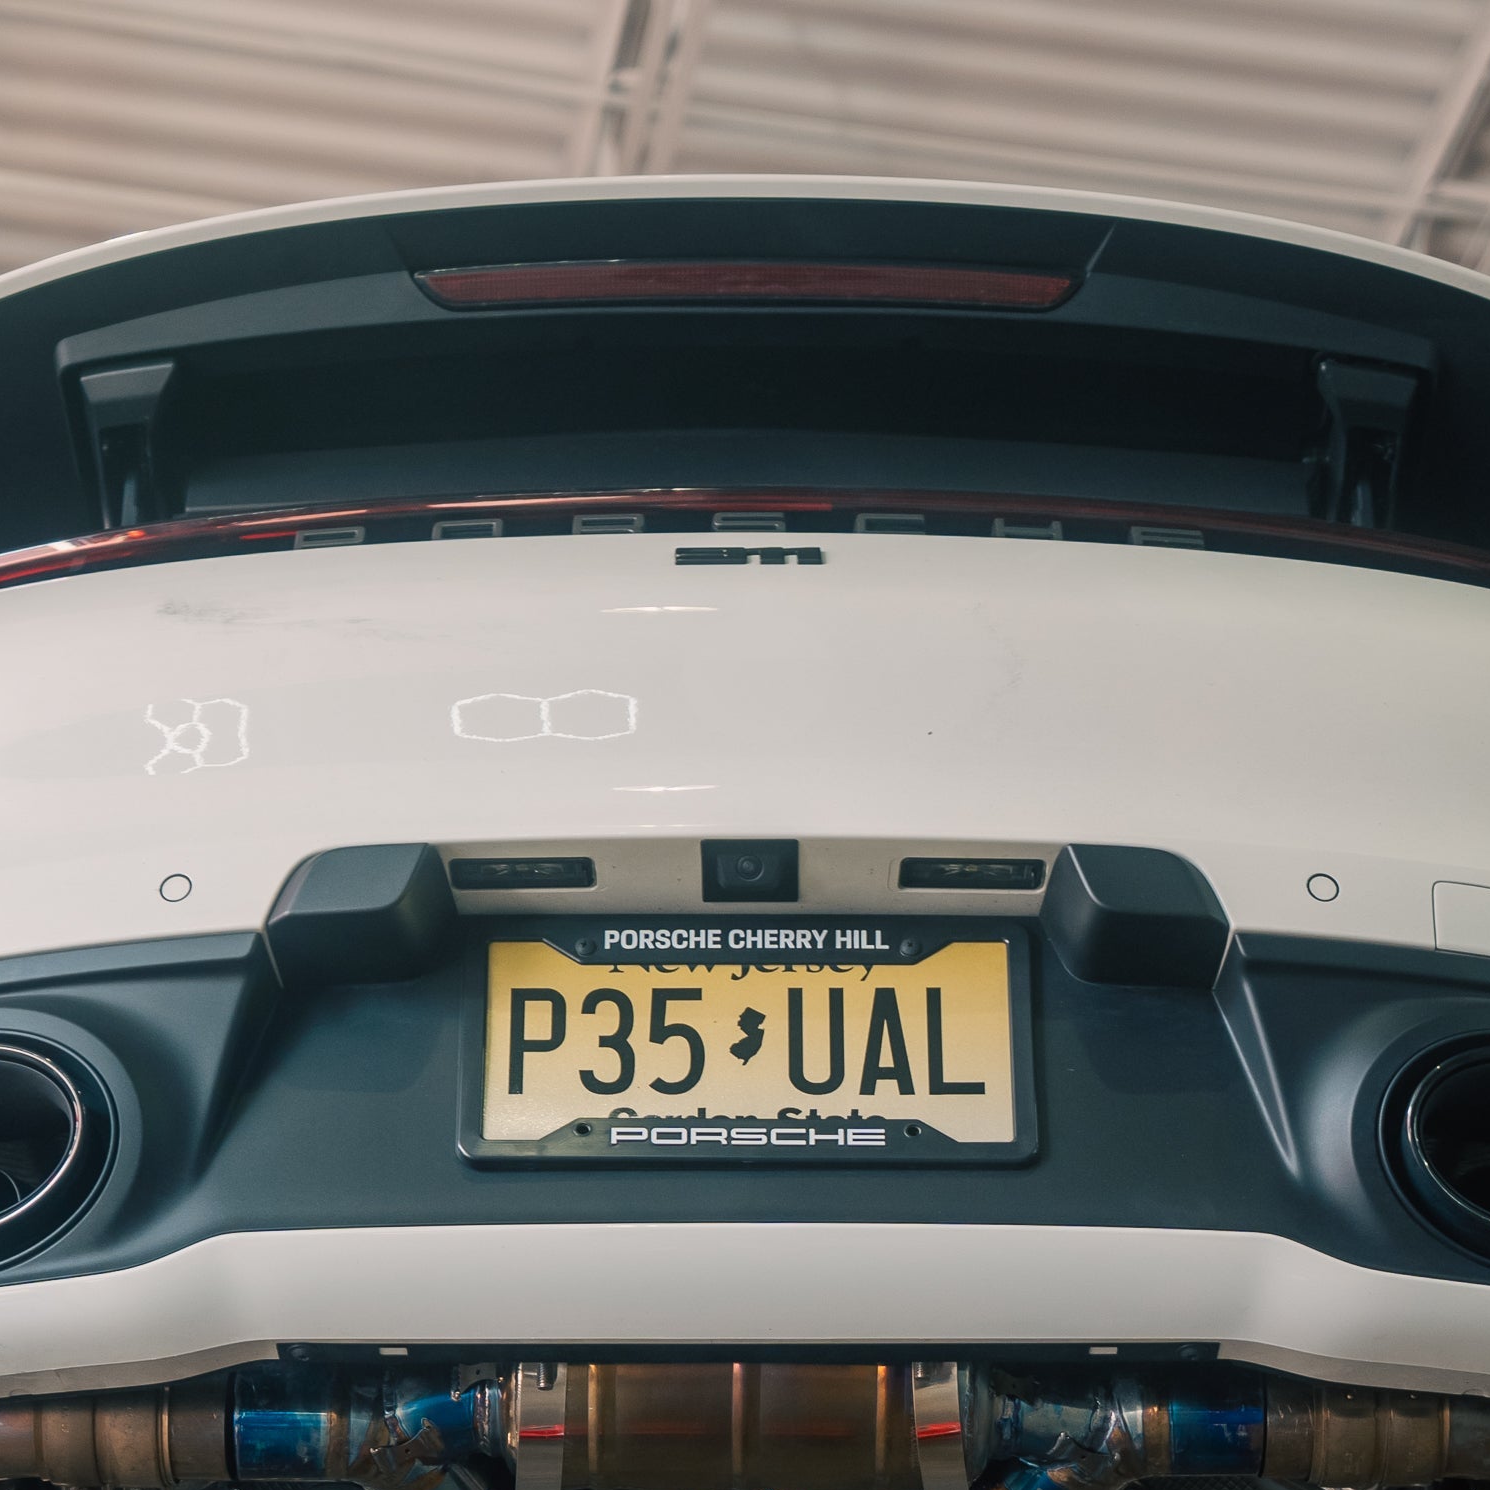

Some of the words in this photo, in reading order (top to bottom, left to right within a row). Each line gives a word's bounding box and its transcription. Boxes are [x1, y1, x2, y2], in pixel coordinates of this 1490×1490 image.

[604, 929, 722, 950] PORSCHE
[728, 929, 828, 950] CHERRY
[835, 929, 890, 950] HILL
[508, 987, 706, 1095] P35
[787, 987, 986, 1095] UAL
[610, 1127, 886, 1146] PORSCHE
